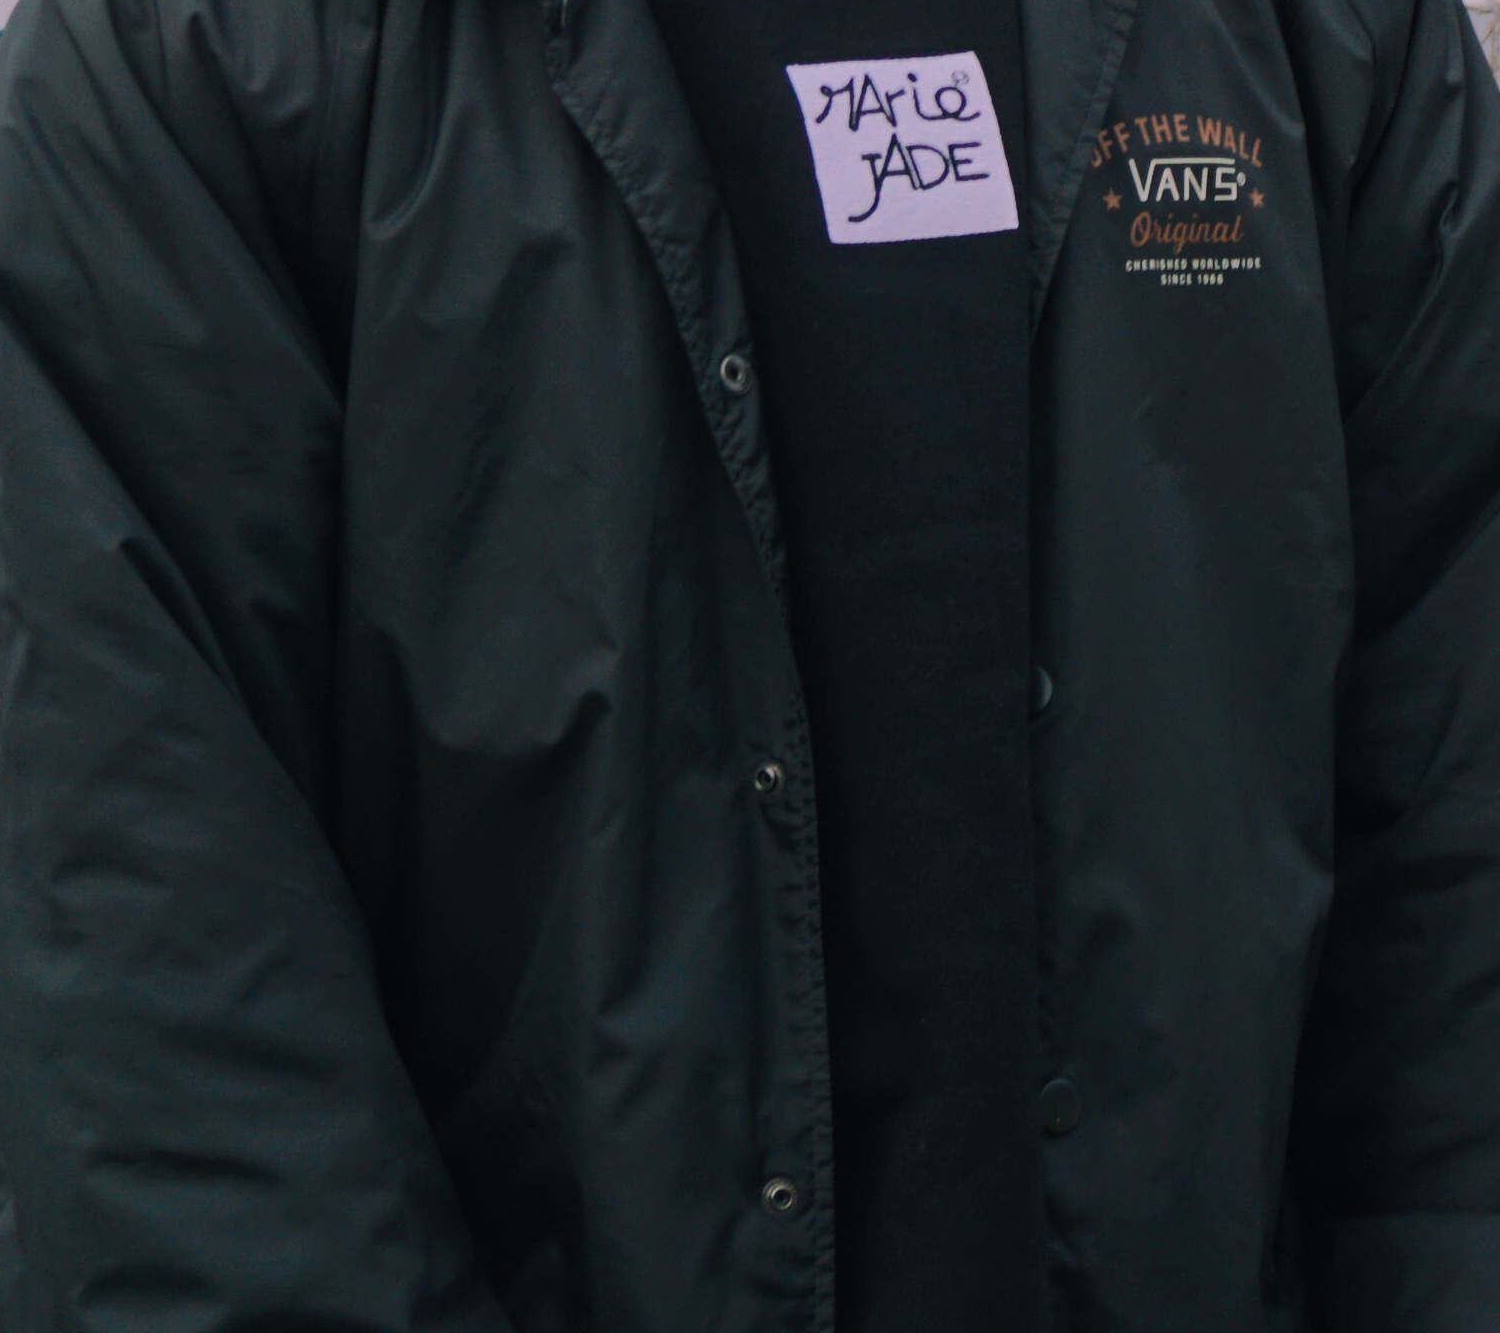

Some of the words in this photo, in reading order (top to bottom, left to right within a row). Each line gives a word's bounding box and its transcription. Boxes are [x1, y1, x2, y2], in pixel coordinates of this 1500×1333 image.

[1134, 112, 1190, 146] THE
[1197, 114, 1264, 168] WALL
[847, 132, 990, 223] JADE
[1130, 211, 1243, 255] Original
[1125, 257, 1189, 273] CHERISHED
[1191, 256, 1263, 272] WORLDWIDE
[1160, 273, 1192, 286] SINCE
